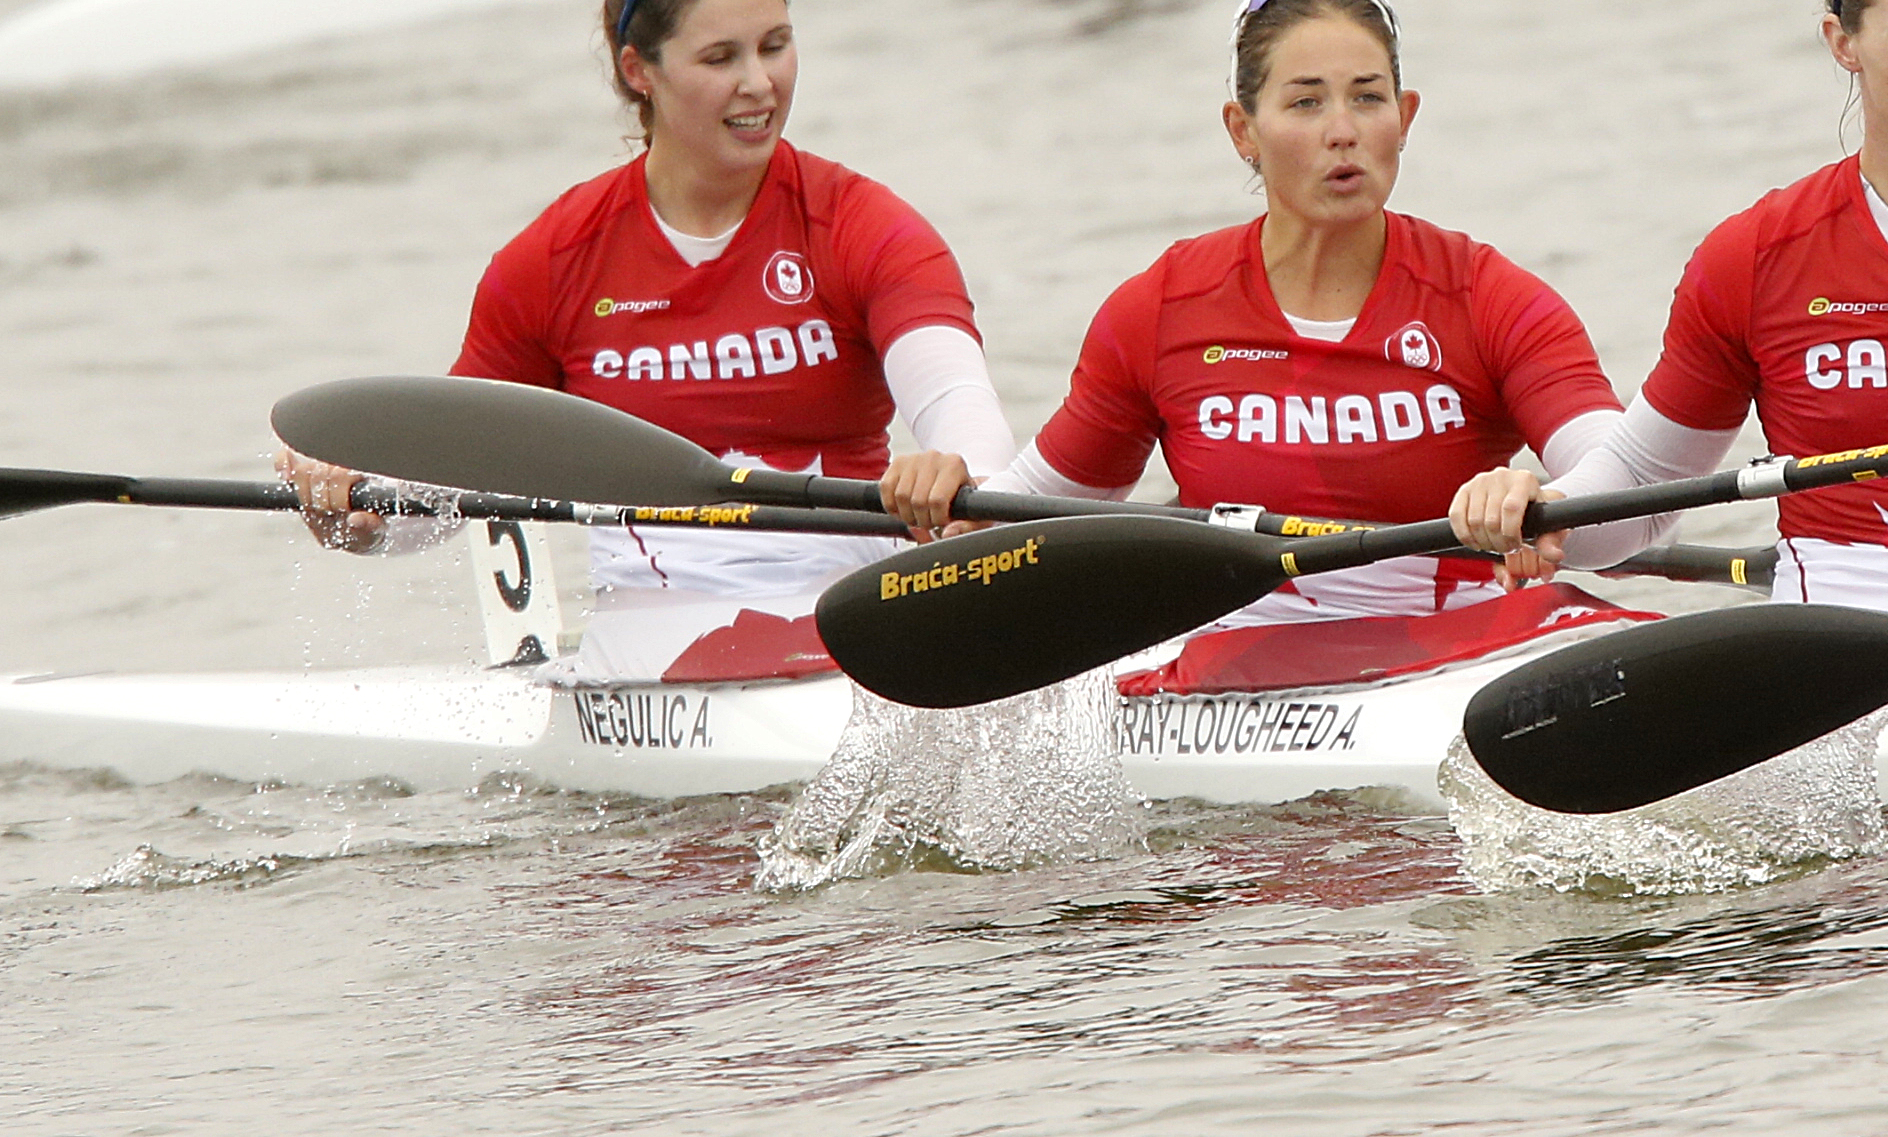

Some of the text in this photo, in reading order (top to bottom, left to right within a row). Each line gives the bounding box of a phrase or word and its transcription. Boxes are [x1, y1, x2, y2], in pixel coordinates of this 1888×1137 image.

[592, 319, 839, 381] CANADA
[1203, 345, 1289, 363] apogee
[1199, 384, 1466, 444] CANADA
[574, 692, 713, 749] NEGULIC A.
[1329, 704, 1364, 750] A.
